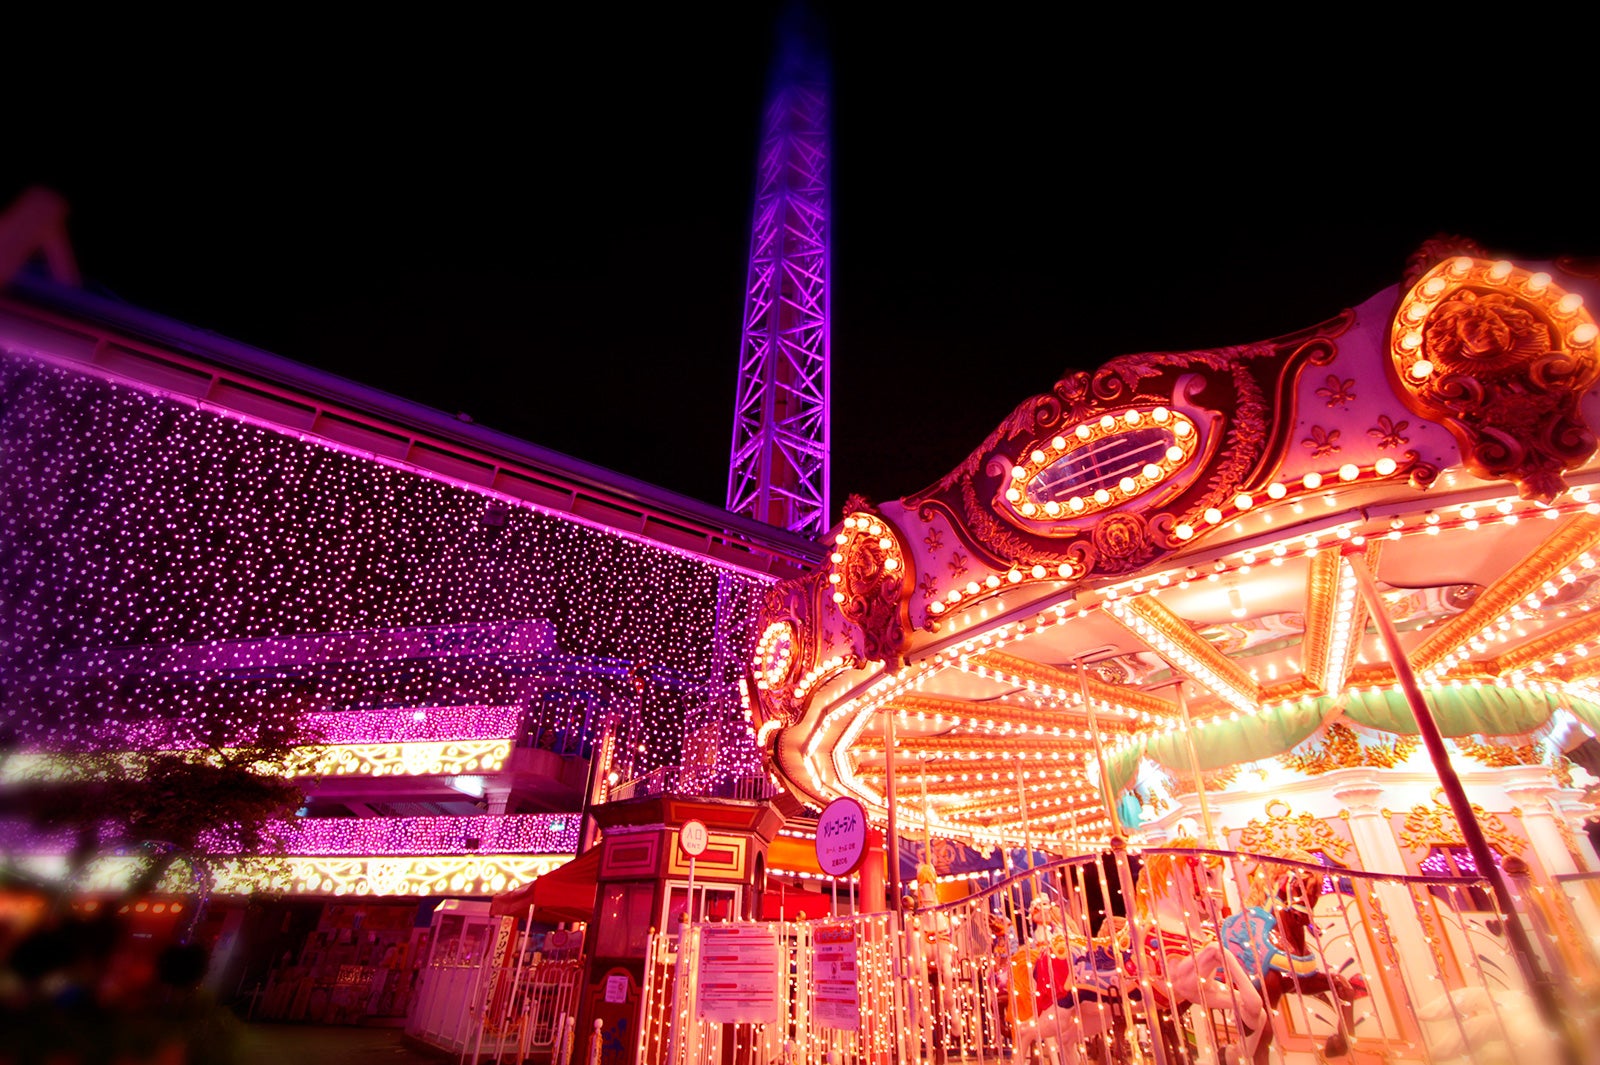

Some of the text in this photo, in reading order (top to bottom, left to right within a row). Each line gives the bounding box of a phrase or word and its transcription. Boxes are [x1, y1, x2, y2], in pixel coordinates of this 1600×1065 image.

[686, 827, 702, 841] 入口
[824, 814, 857, 838] メリーゴーランド
